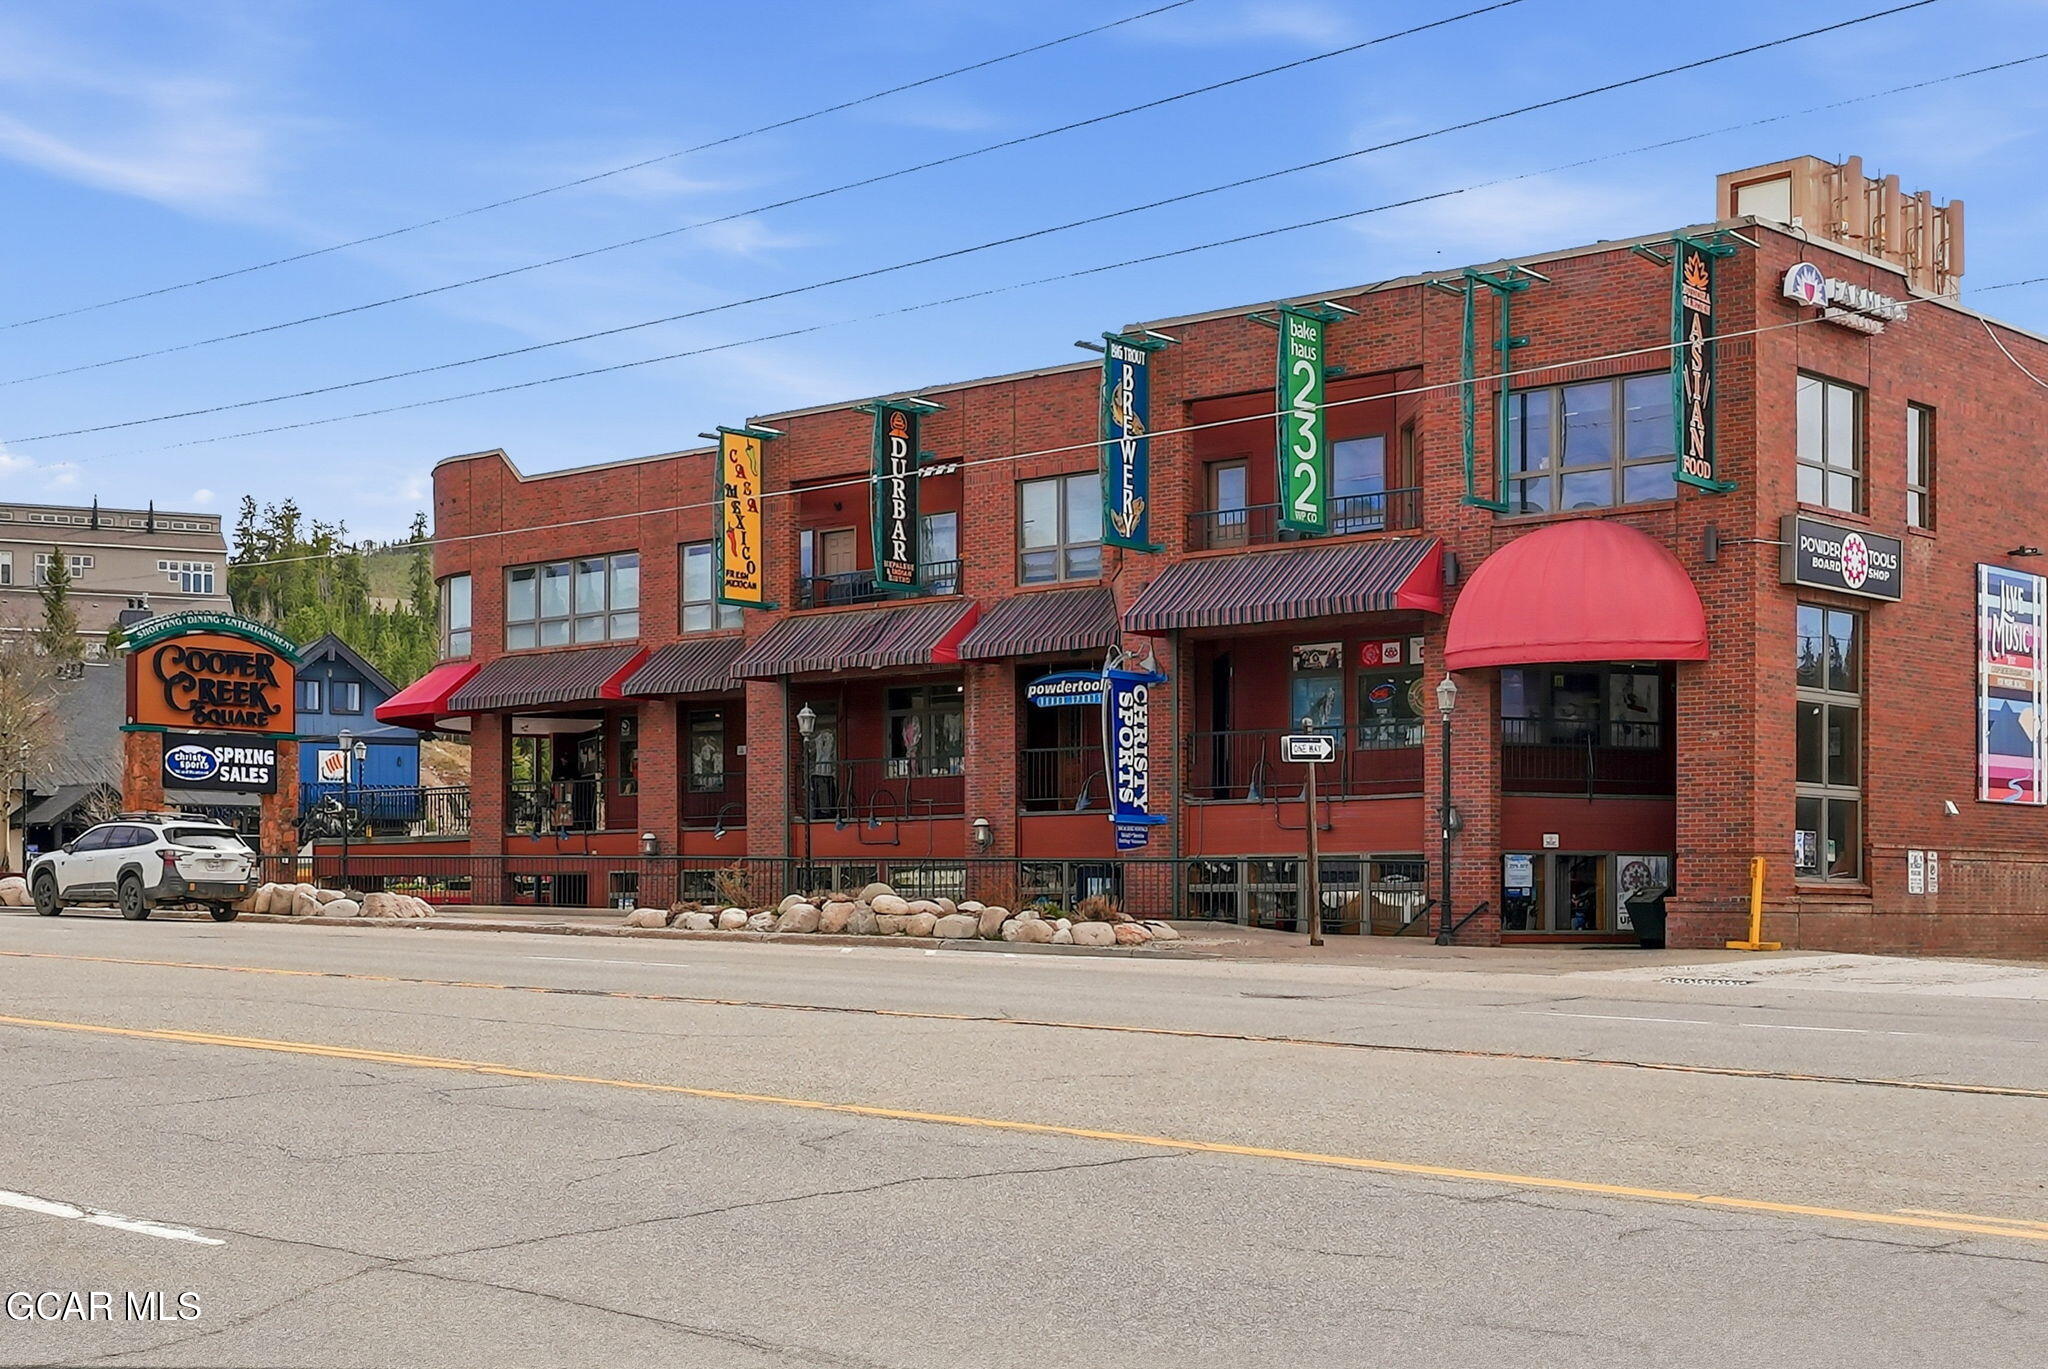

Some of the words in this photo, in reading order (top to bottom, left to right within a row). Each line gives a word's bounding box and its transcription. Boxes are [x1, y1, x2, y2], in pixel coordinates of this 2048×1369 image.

[1290, 318, 1317, 342] bake
[1111, 343, 1124, 360] BIG
[1124, 346, 1146, 366] TROUT
[1290, 337, 1317, 361] haus
[1689, 313, 1705, 459] ASIAN
[1120, 363, 1137, 538] BREWERY
[1293, 360, 1318, 512] 2232
[729, 449, 759, 514] CASA
[1683, 455, 1712, 479] FOOD
[891, 437, 908, 562] DURBAR
[724, 483, 756, 575] MEXICO
[1800, 535, 1841, 558] POWDER
[1868, 549, 1898, 569] TOOLS
[1812, 556, 1841, 573] BOARD
[1868, 568, 1891, 581] SHOP
[725, 579, 757, 589] MEXICAN
[726, 569, 749, 580] FRESH
[2000, 579, 2025, 623] LIVE
[136, 617, 183, 640] SHOPPING
[187, 615, 220, 625] DINING
[225, 617, 296, 652] ENTERTAINMENT
[1991, 613, 2031, 658] MUSIC
[153, 644, 280, 688] COOPER
[164, 671, 282, 716] CREEK
[192, 704, 269, 727] SQUARE
[174, 752, 207, 764] christy
[214, 747, 275, 766] SPRING
[1118, 691, 1134, 804] SPORTS
[1133, 684, 1148, 814] CHRISTY
[180, 761, 210, 770] sports
[219, 766, 269, 784] SALES
